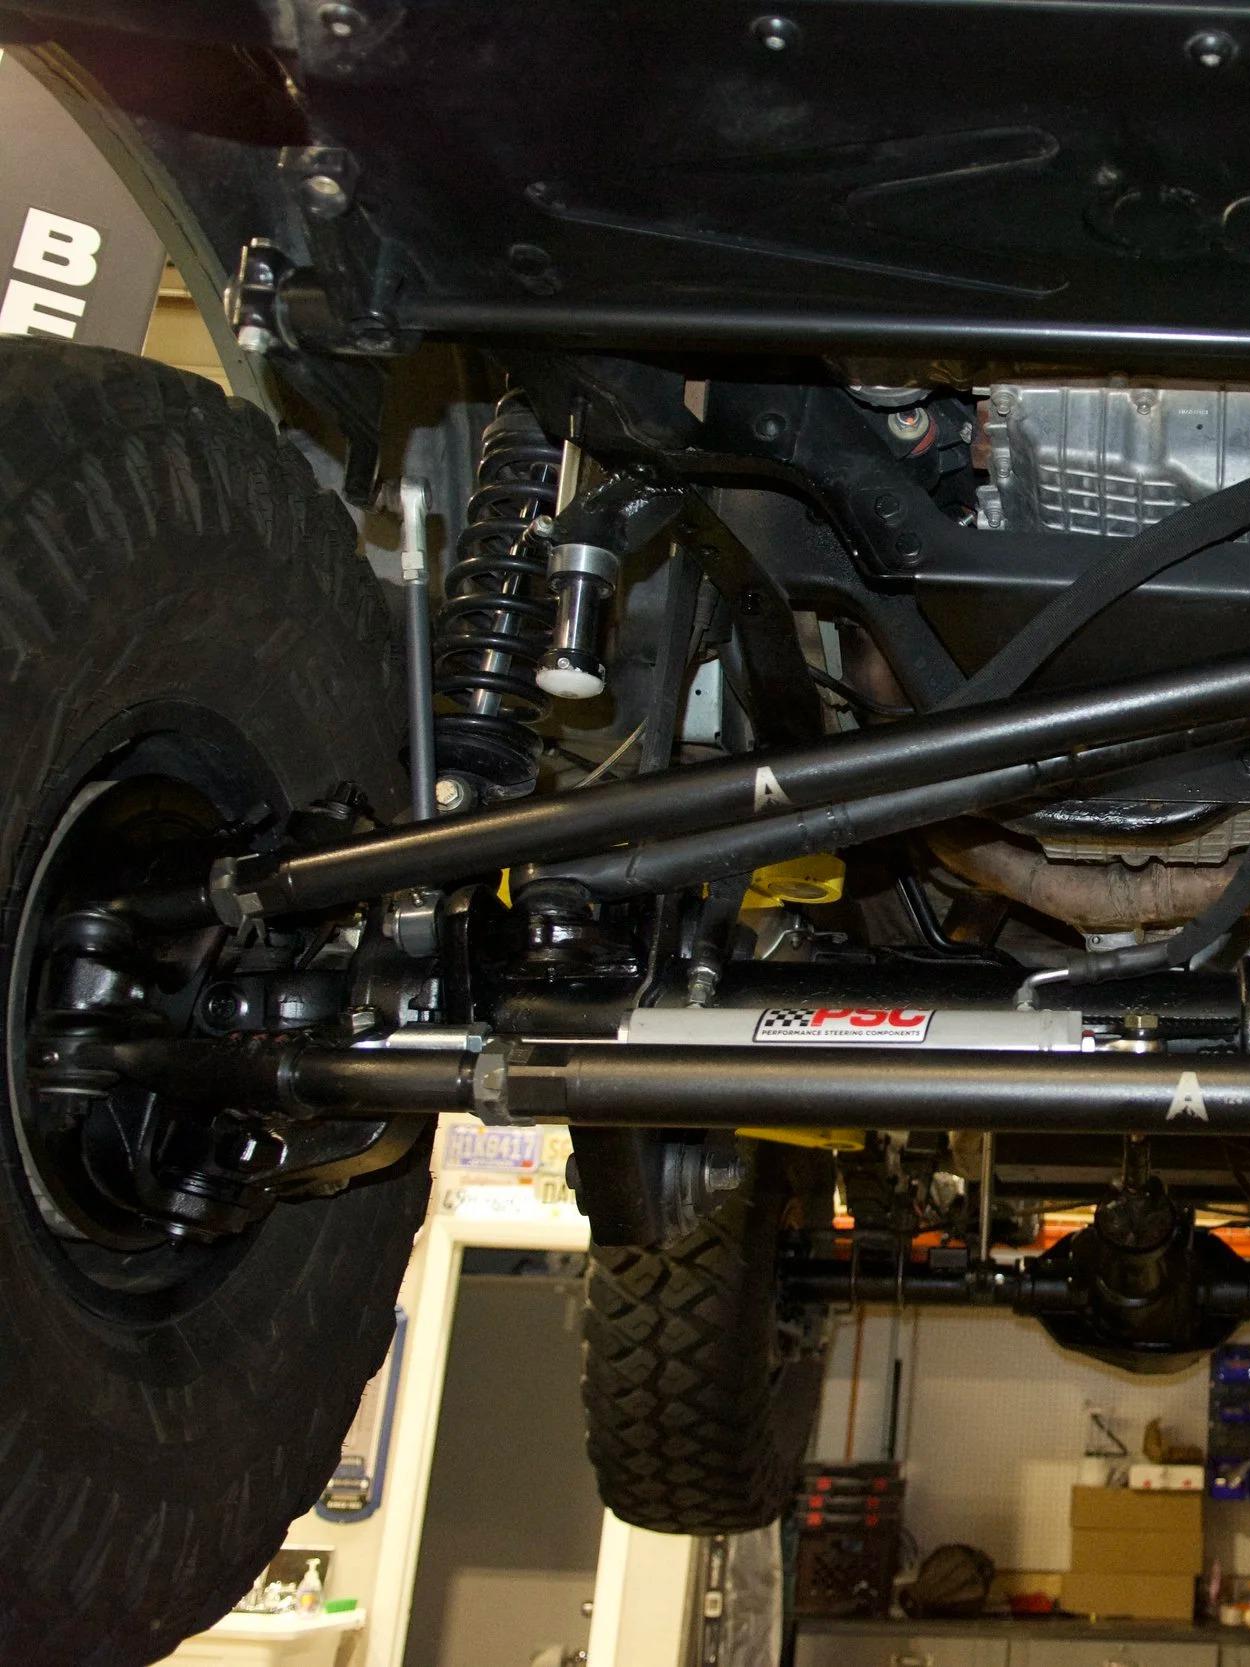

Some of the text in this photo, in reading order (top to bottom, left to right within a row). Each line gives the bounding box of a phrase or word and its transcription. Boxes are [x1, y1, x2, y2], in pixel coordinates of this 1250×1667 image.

[810, 1007, 926, 1027] PSC
[761, 1029, 921, 1037] PERFORMANCE STEERING COMPONENTS
[1166, 1071, 1209, 1121] A
